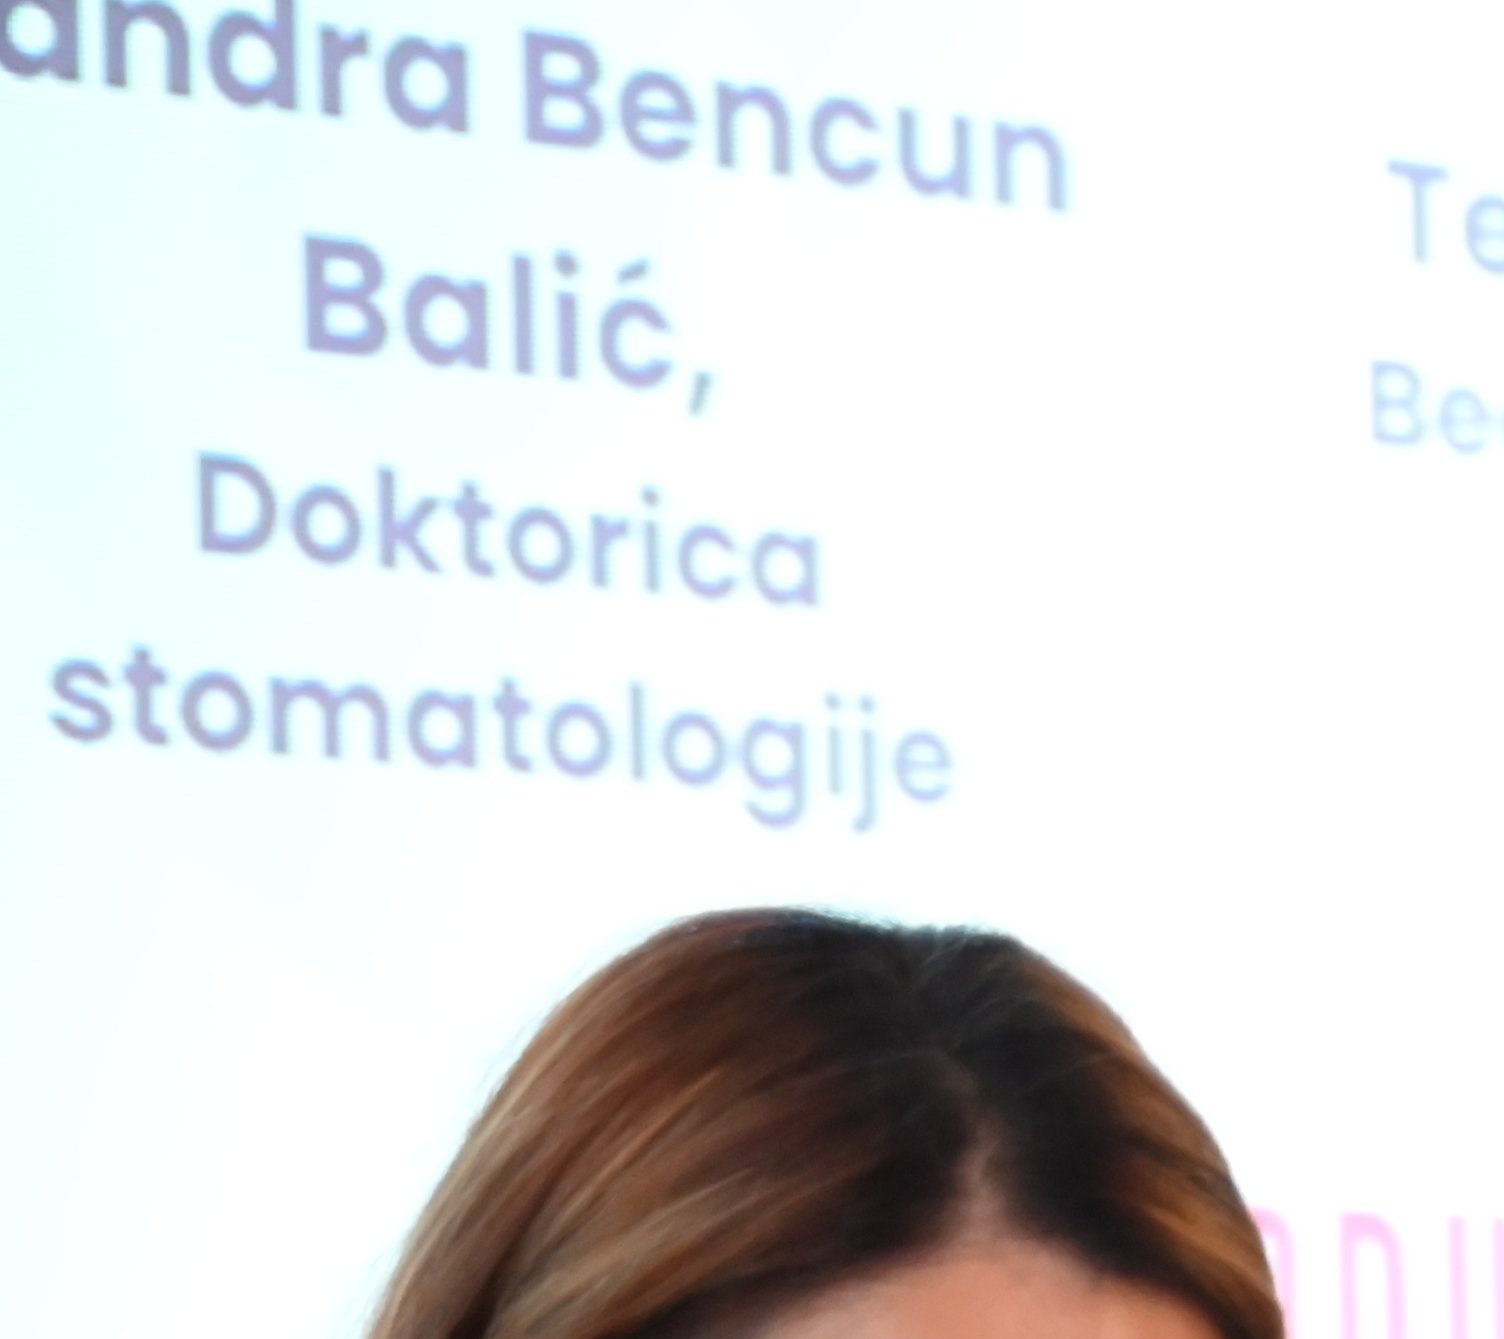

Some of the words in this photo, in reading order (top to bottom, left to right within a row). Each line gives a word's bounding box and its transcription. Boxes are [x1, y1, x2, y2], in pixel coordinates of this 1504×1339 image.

[520, 26, 1068, 211] Bencun
[300, 231, 713, 415] Balić,
[194, 449, 820, 607] Doktorica
[45, 641, 953, 834] stomatologije
